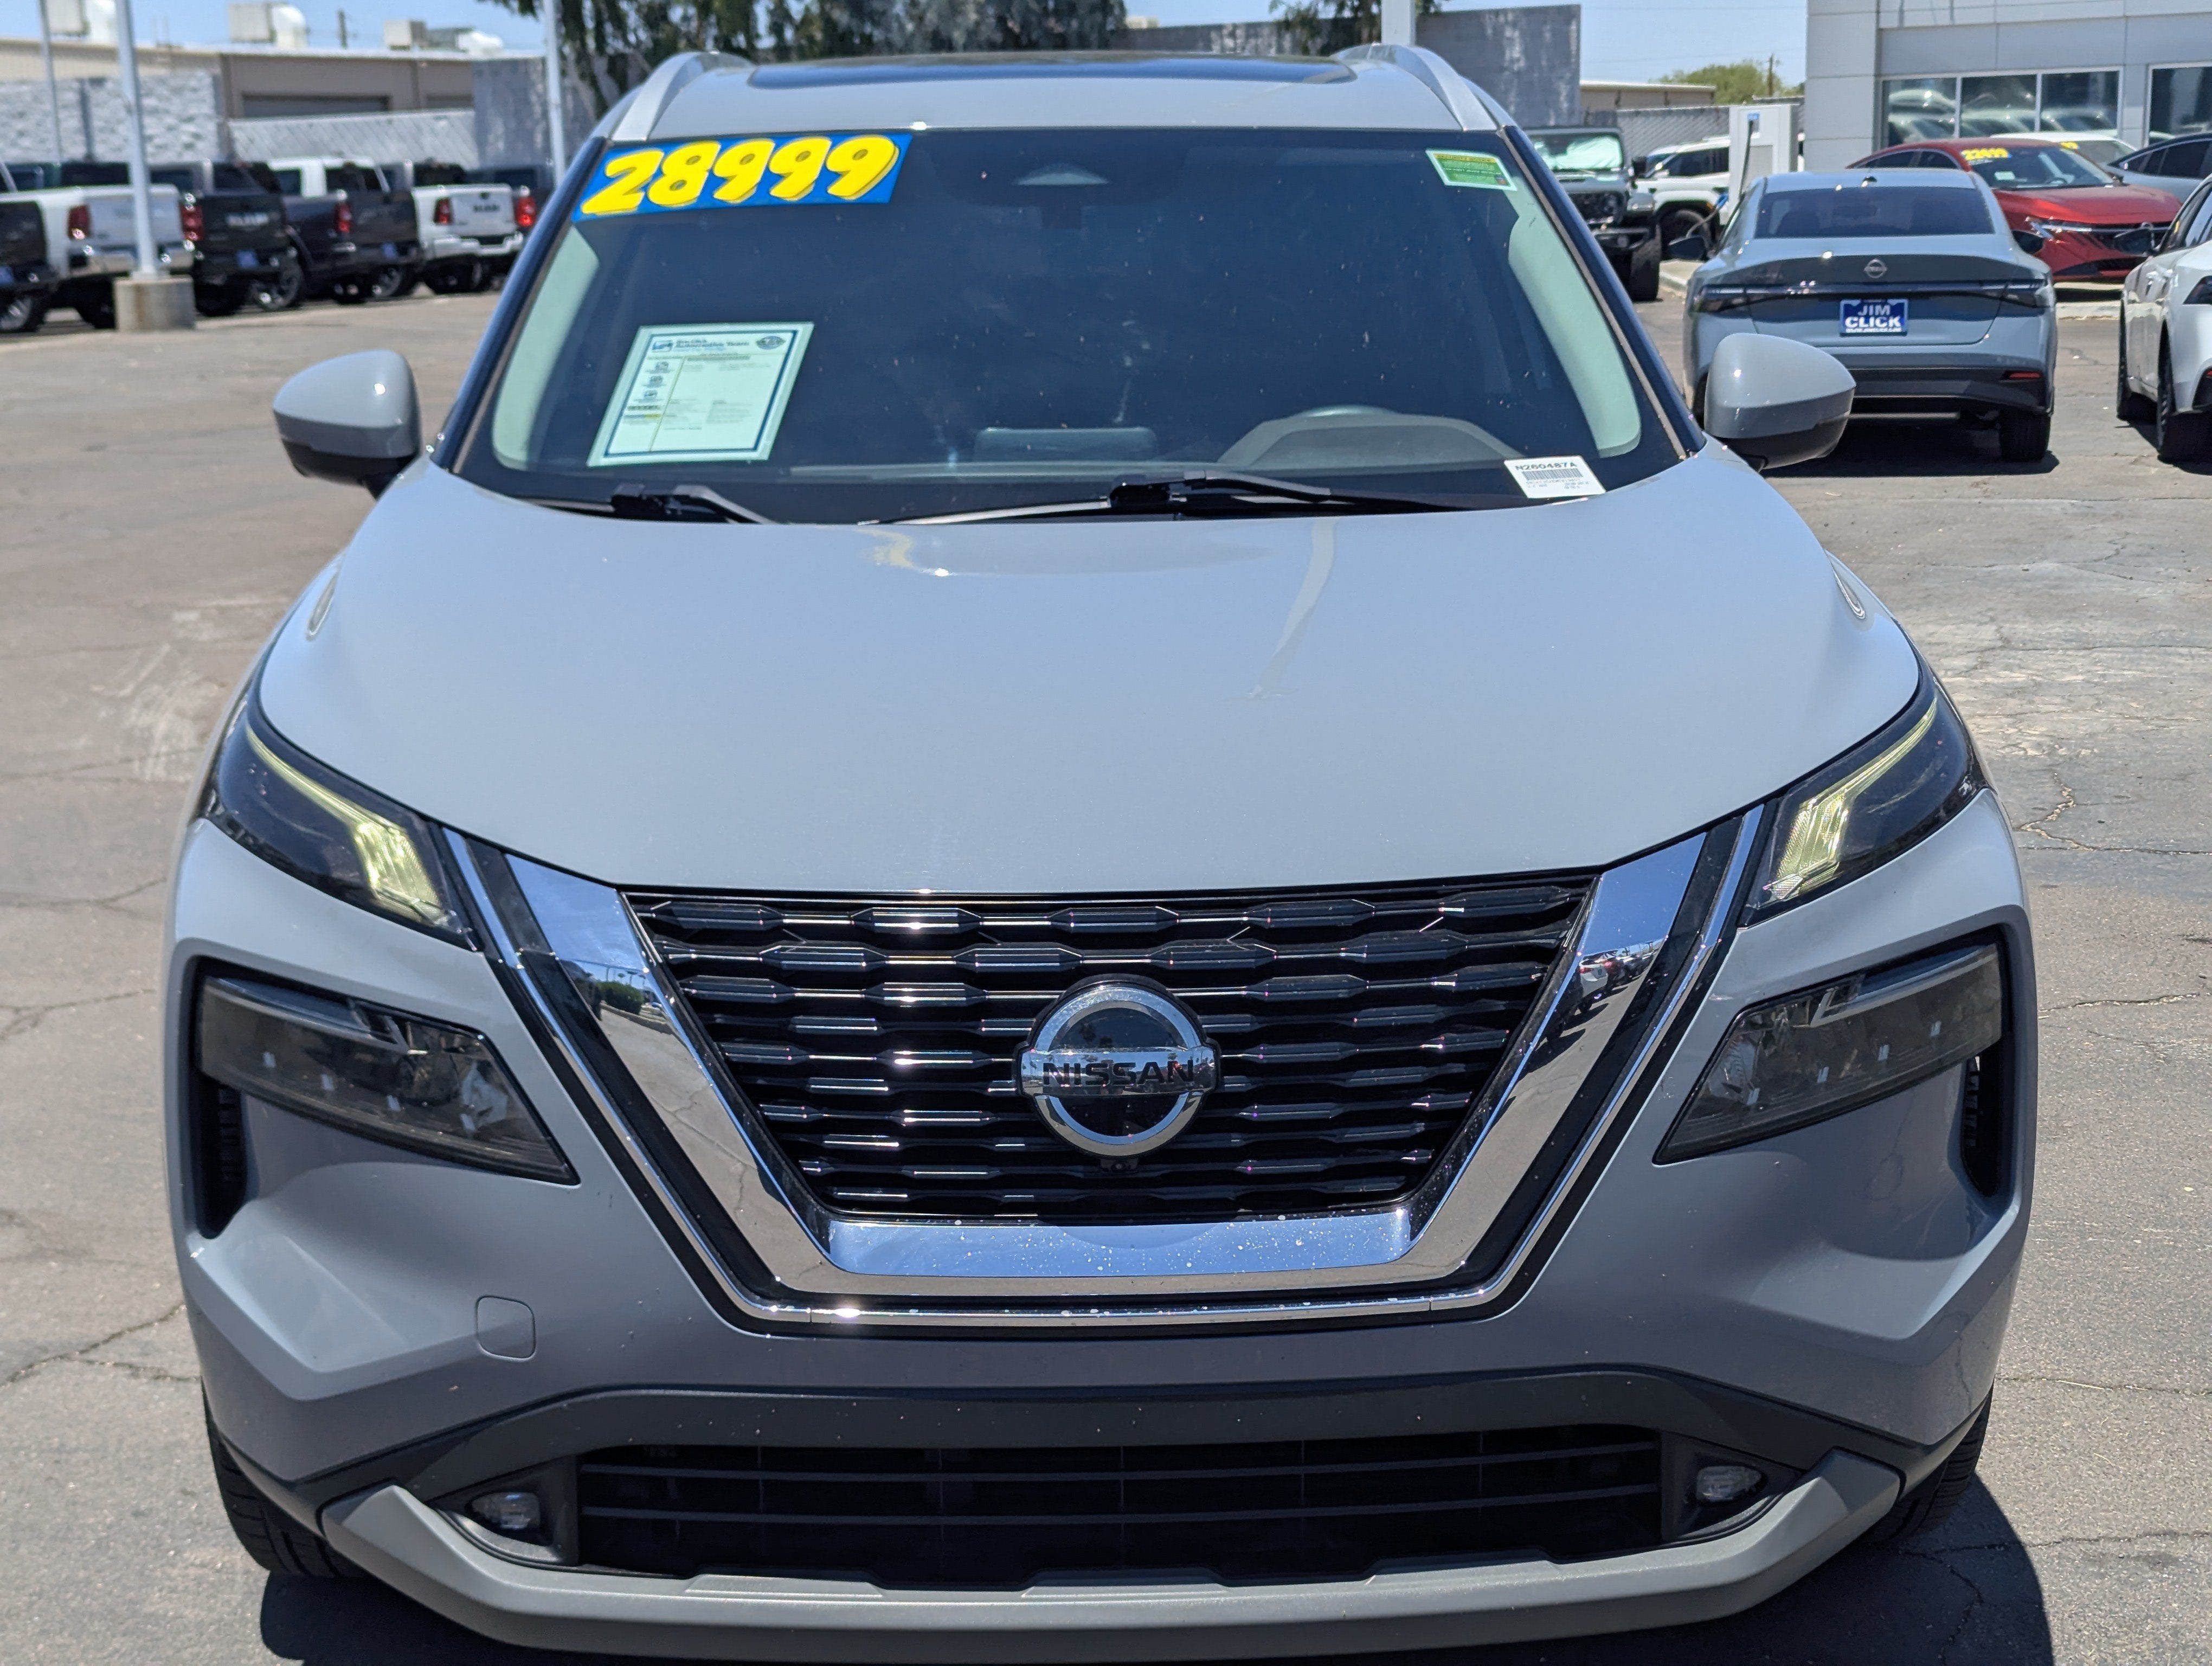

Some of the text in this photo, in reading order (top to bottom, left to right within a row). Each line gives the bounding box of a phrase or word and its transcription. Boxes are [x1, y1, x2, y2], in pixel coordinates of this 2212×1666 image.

[581, 134, 900, 215] 28999
[1857, 305, 1891, 316] JIM
[1845, 316, 1901, 328] CLICK
[1042, 1059, 1194, 1086] NISSAN
